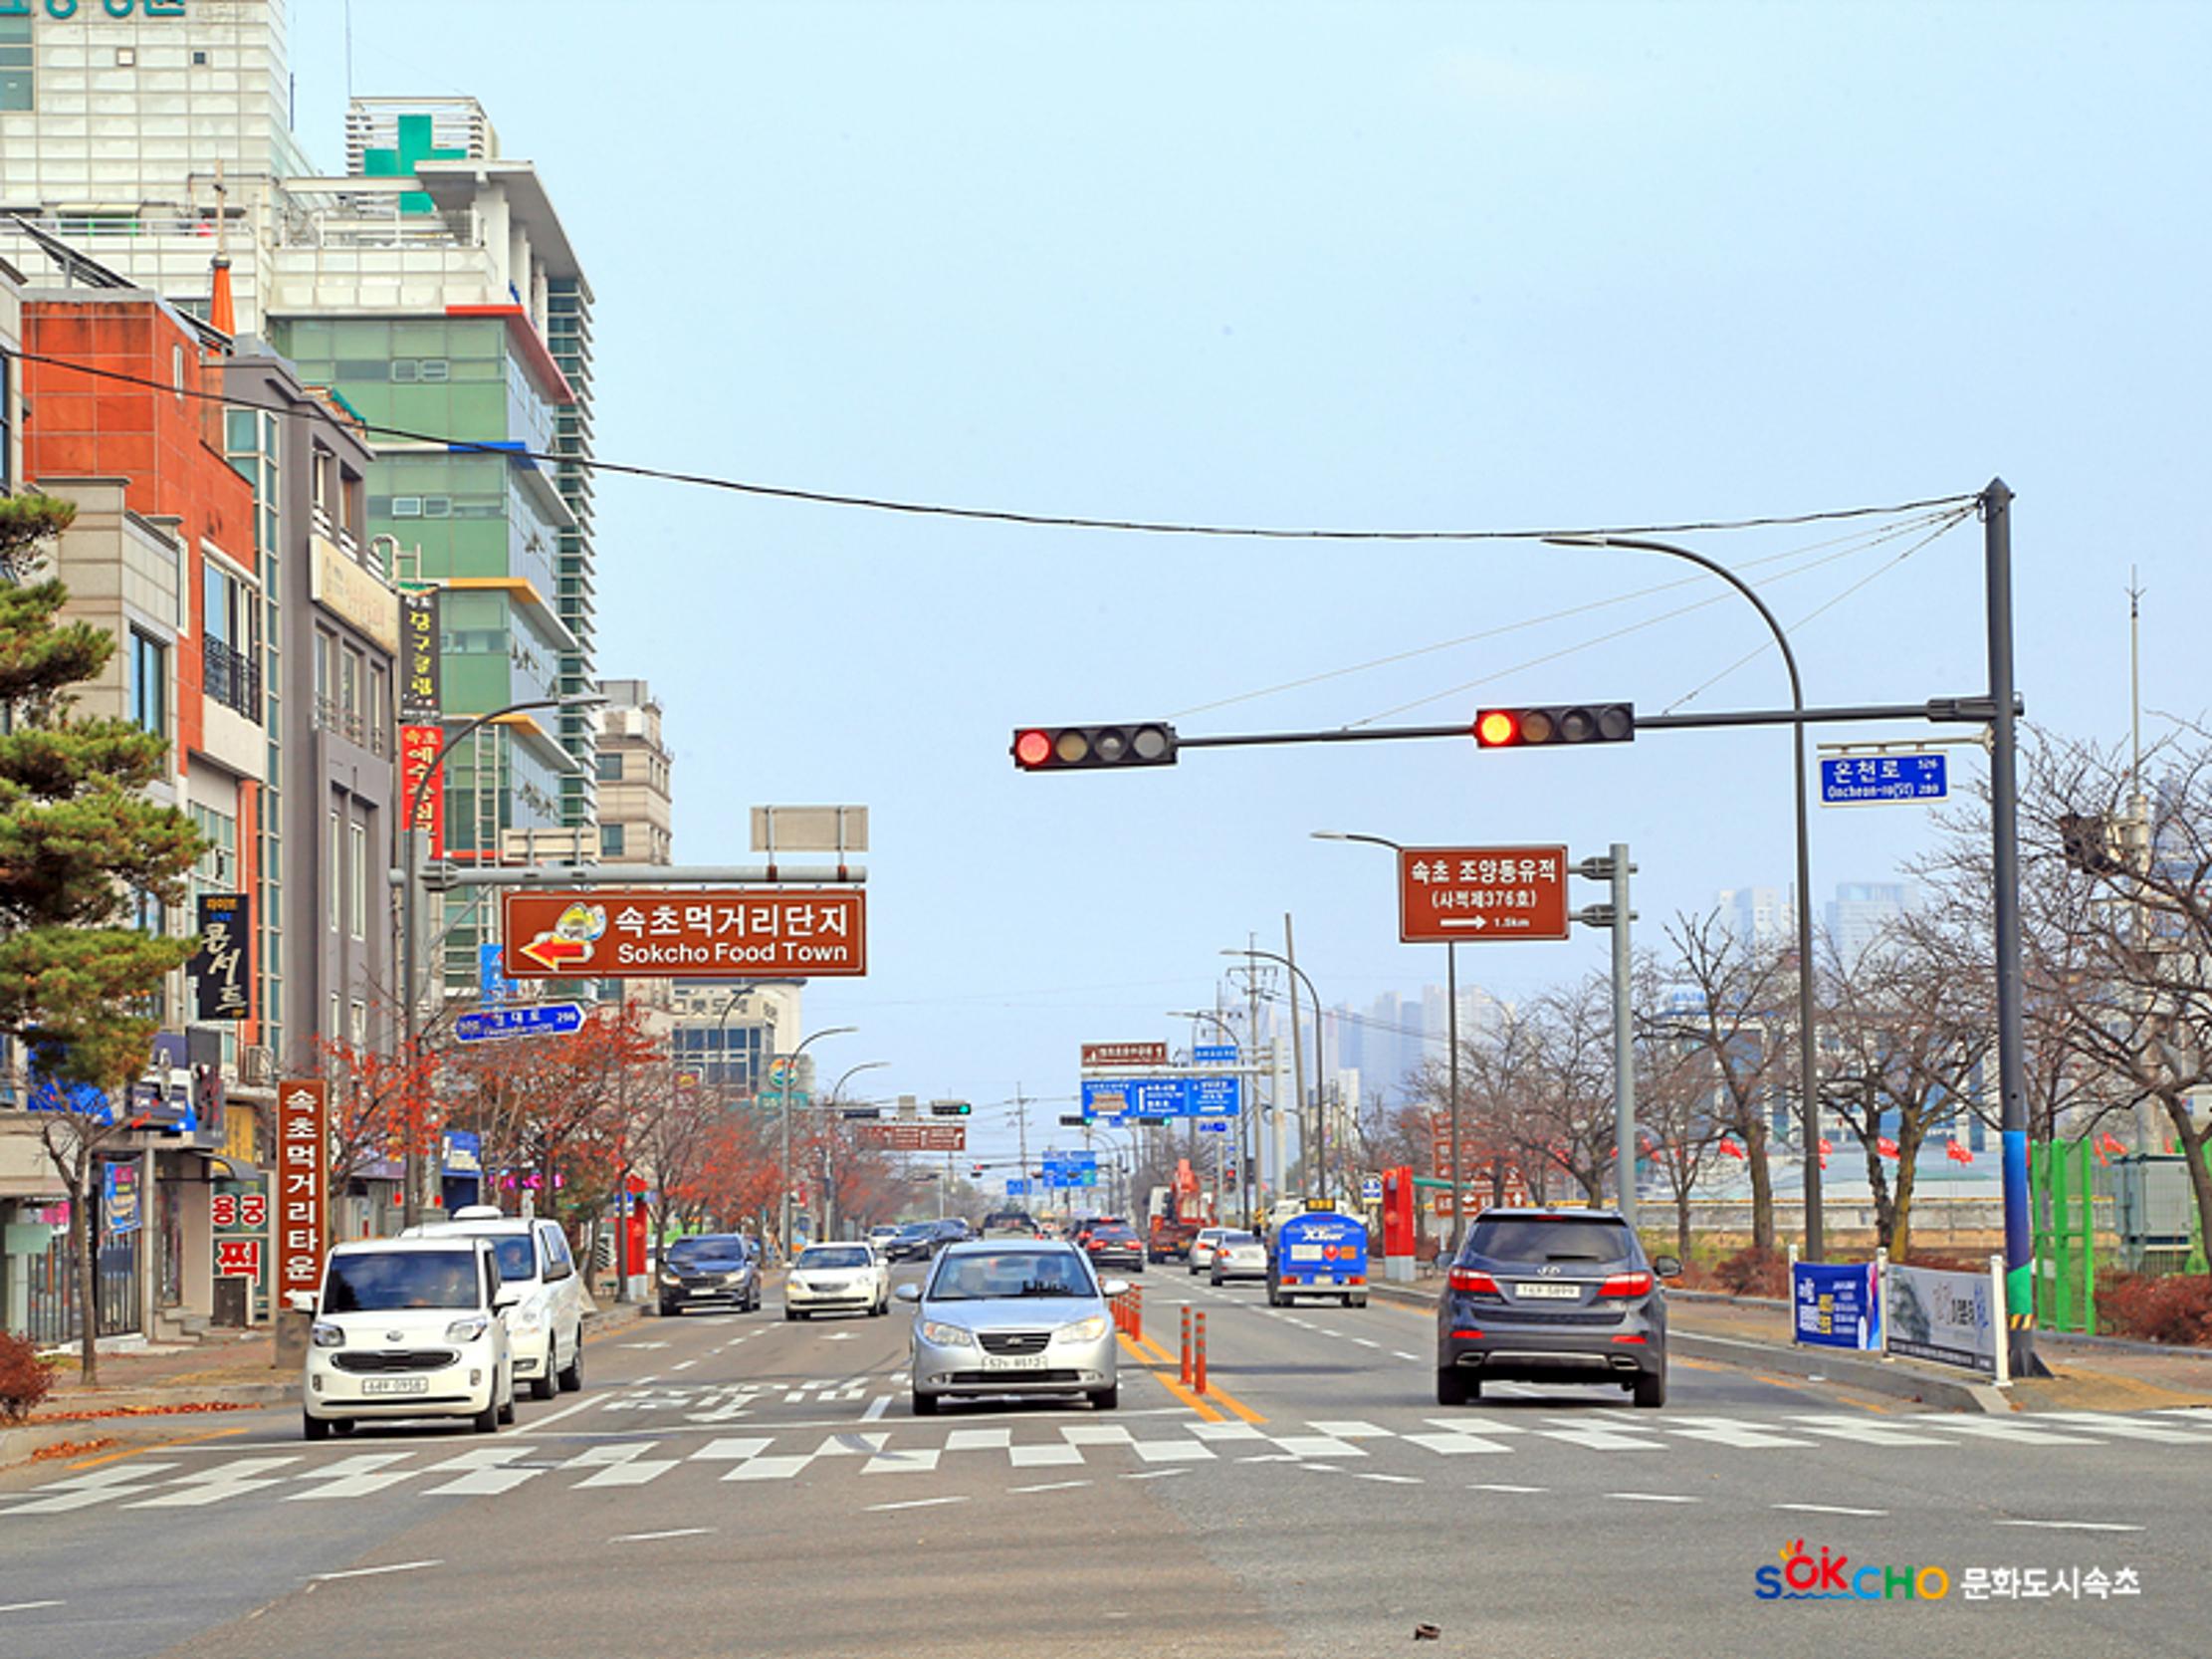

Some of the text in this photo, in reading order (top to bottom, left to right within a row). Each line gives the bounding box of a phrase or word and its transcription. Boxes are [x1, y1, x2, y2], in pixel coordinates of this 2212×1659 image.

[1833, 760, 1900, 784] 온천로
[1412, 858, 1556, 885] 속초 조양동유적
[614, 904, 848, 938] 속초먹거리단지
[201, 922, 248, 1012] 콘서트
[618, 941, 848, 964] Sokcho Food Town
[285, 1088, 319, 1283] 속초먹거리타운
[212, 1194, 266, 1226] 용궁
